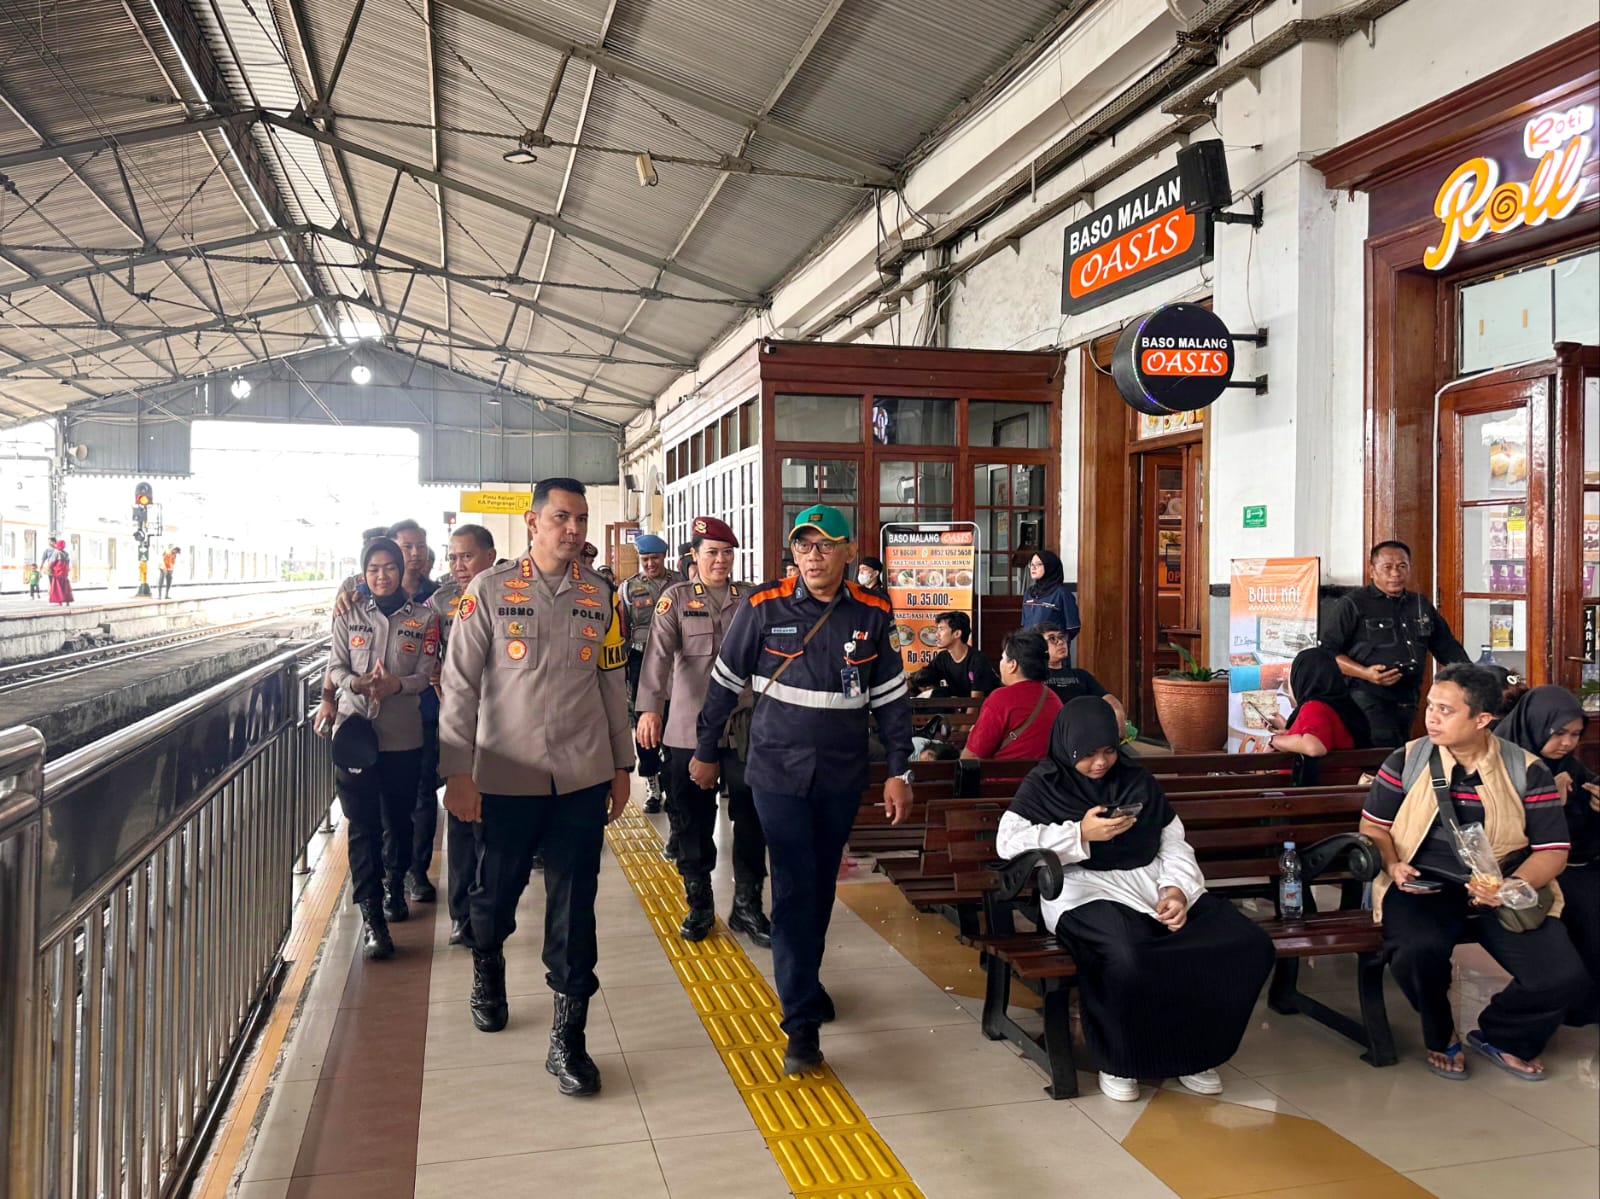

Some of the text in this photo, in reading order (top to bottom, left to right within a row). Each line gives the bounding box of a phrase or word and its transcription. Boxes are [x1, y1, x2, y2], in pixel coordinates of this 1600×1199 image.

[1528, 111, 1583, 152] Roti
[1423, 135, 1586, 270] Roll
[1070, 176, 1181, 256] BASO MALAN
[1080, 215, 1180, 288] OASIS
[1142, 337, 1228, 349] BASO MALANG
[1147, 351, 1223, 374] OASIS
[889, 533, 909, 543] BASO
[910, 533, 939, 543] MALANG
[907, 592, 919, 607] Rp.
[1248, 585, 1277, 604] BOLU
[498, 607, 534, 616] BISMO
[572, 608, 605, 620] POLRI
